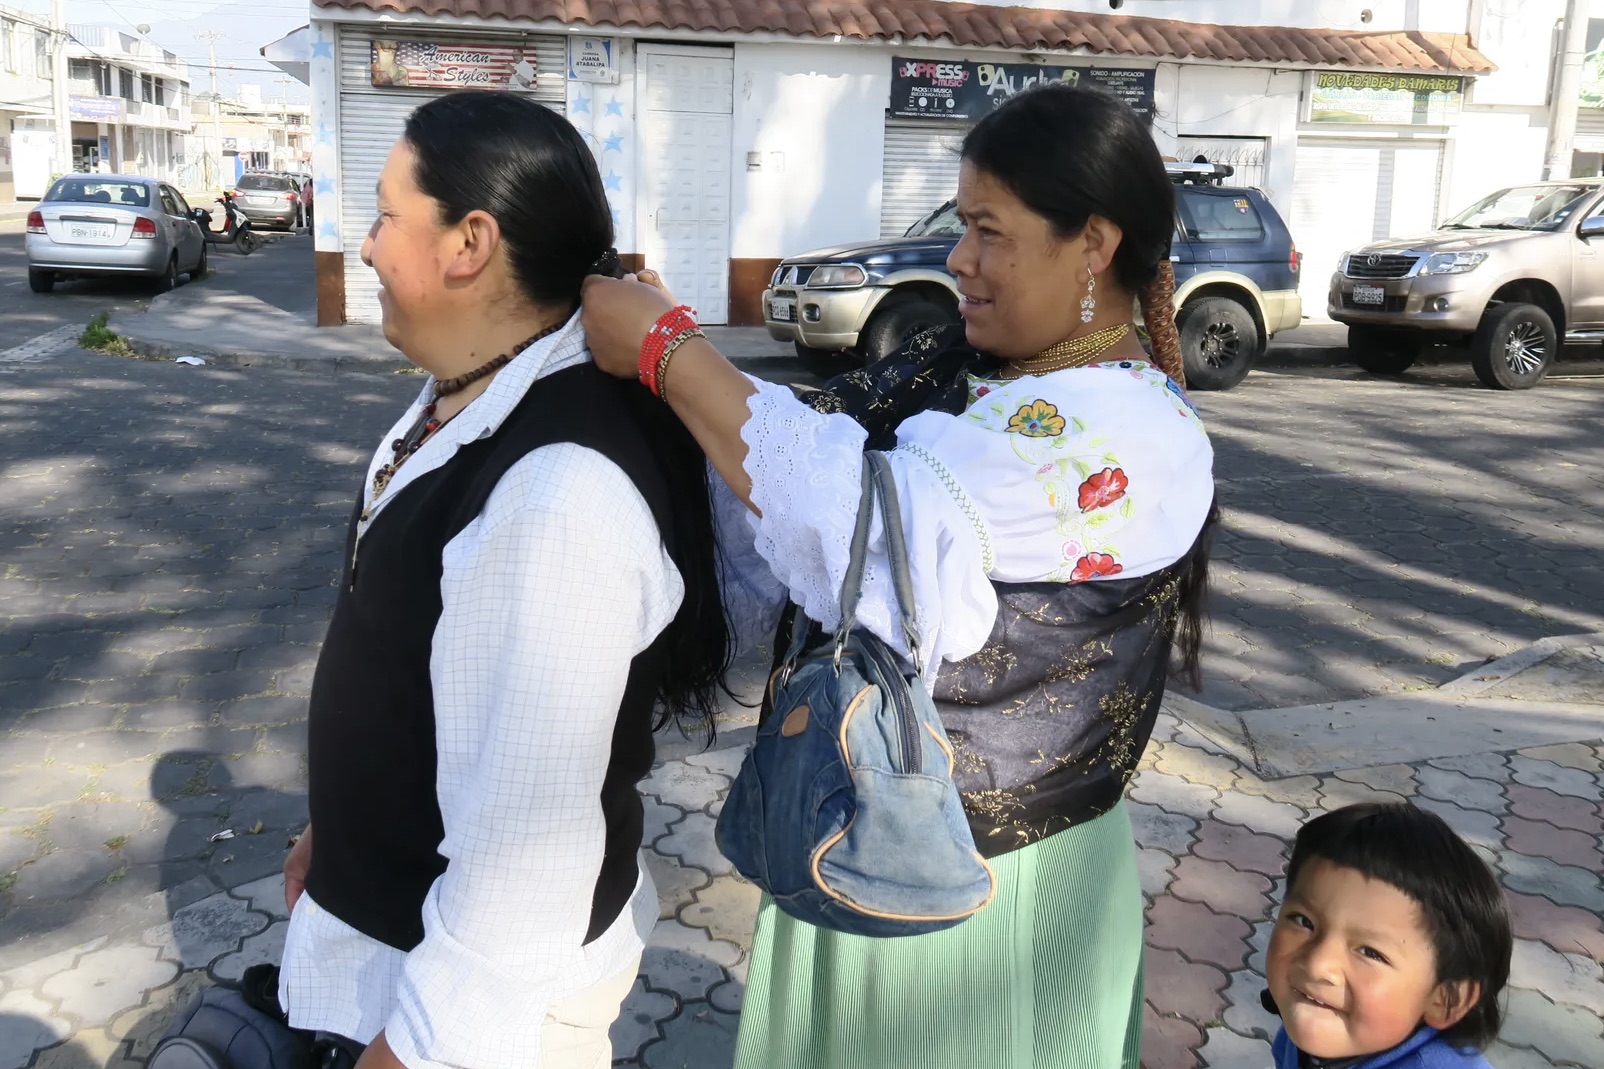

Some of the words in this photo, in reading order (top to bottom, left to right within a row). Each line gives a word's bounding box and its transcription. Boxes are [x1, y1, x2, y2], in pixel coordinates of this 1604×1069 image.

[419, 45, 489, 64] American
[444, 67, 490, 84] Styles
[906, 62, 963, 80] XPRESS
[1317, 73, 1396, 88] NOVEDADES
[1398, 77, 1459, 91] DAMARIS
